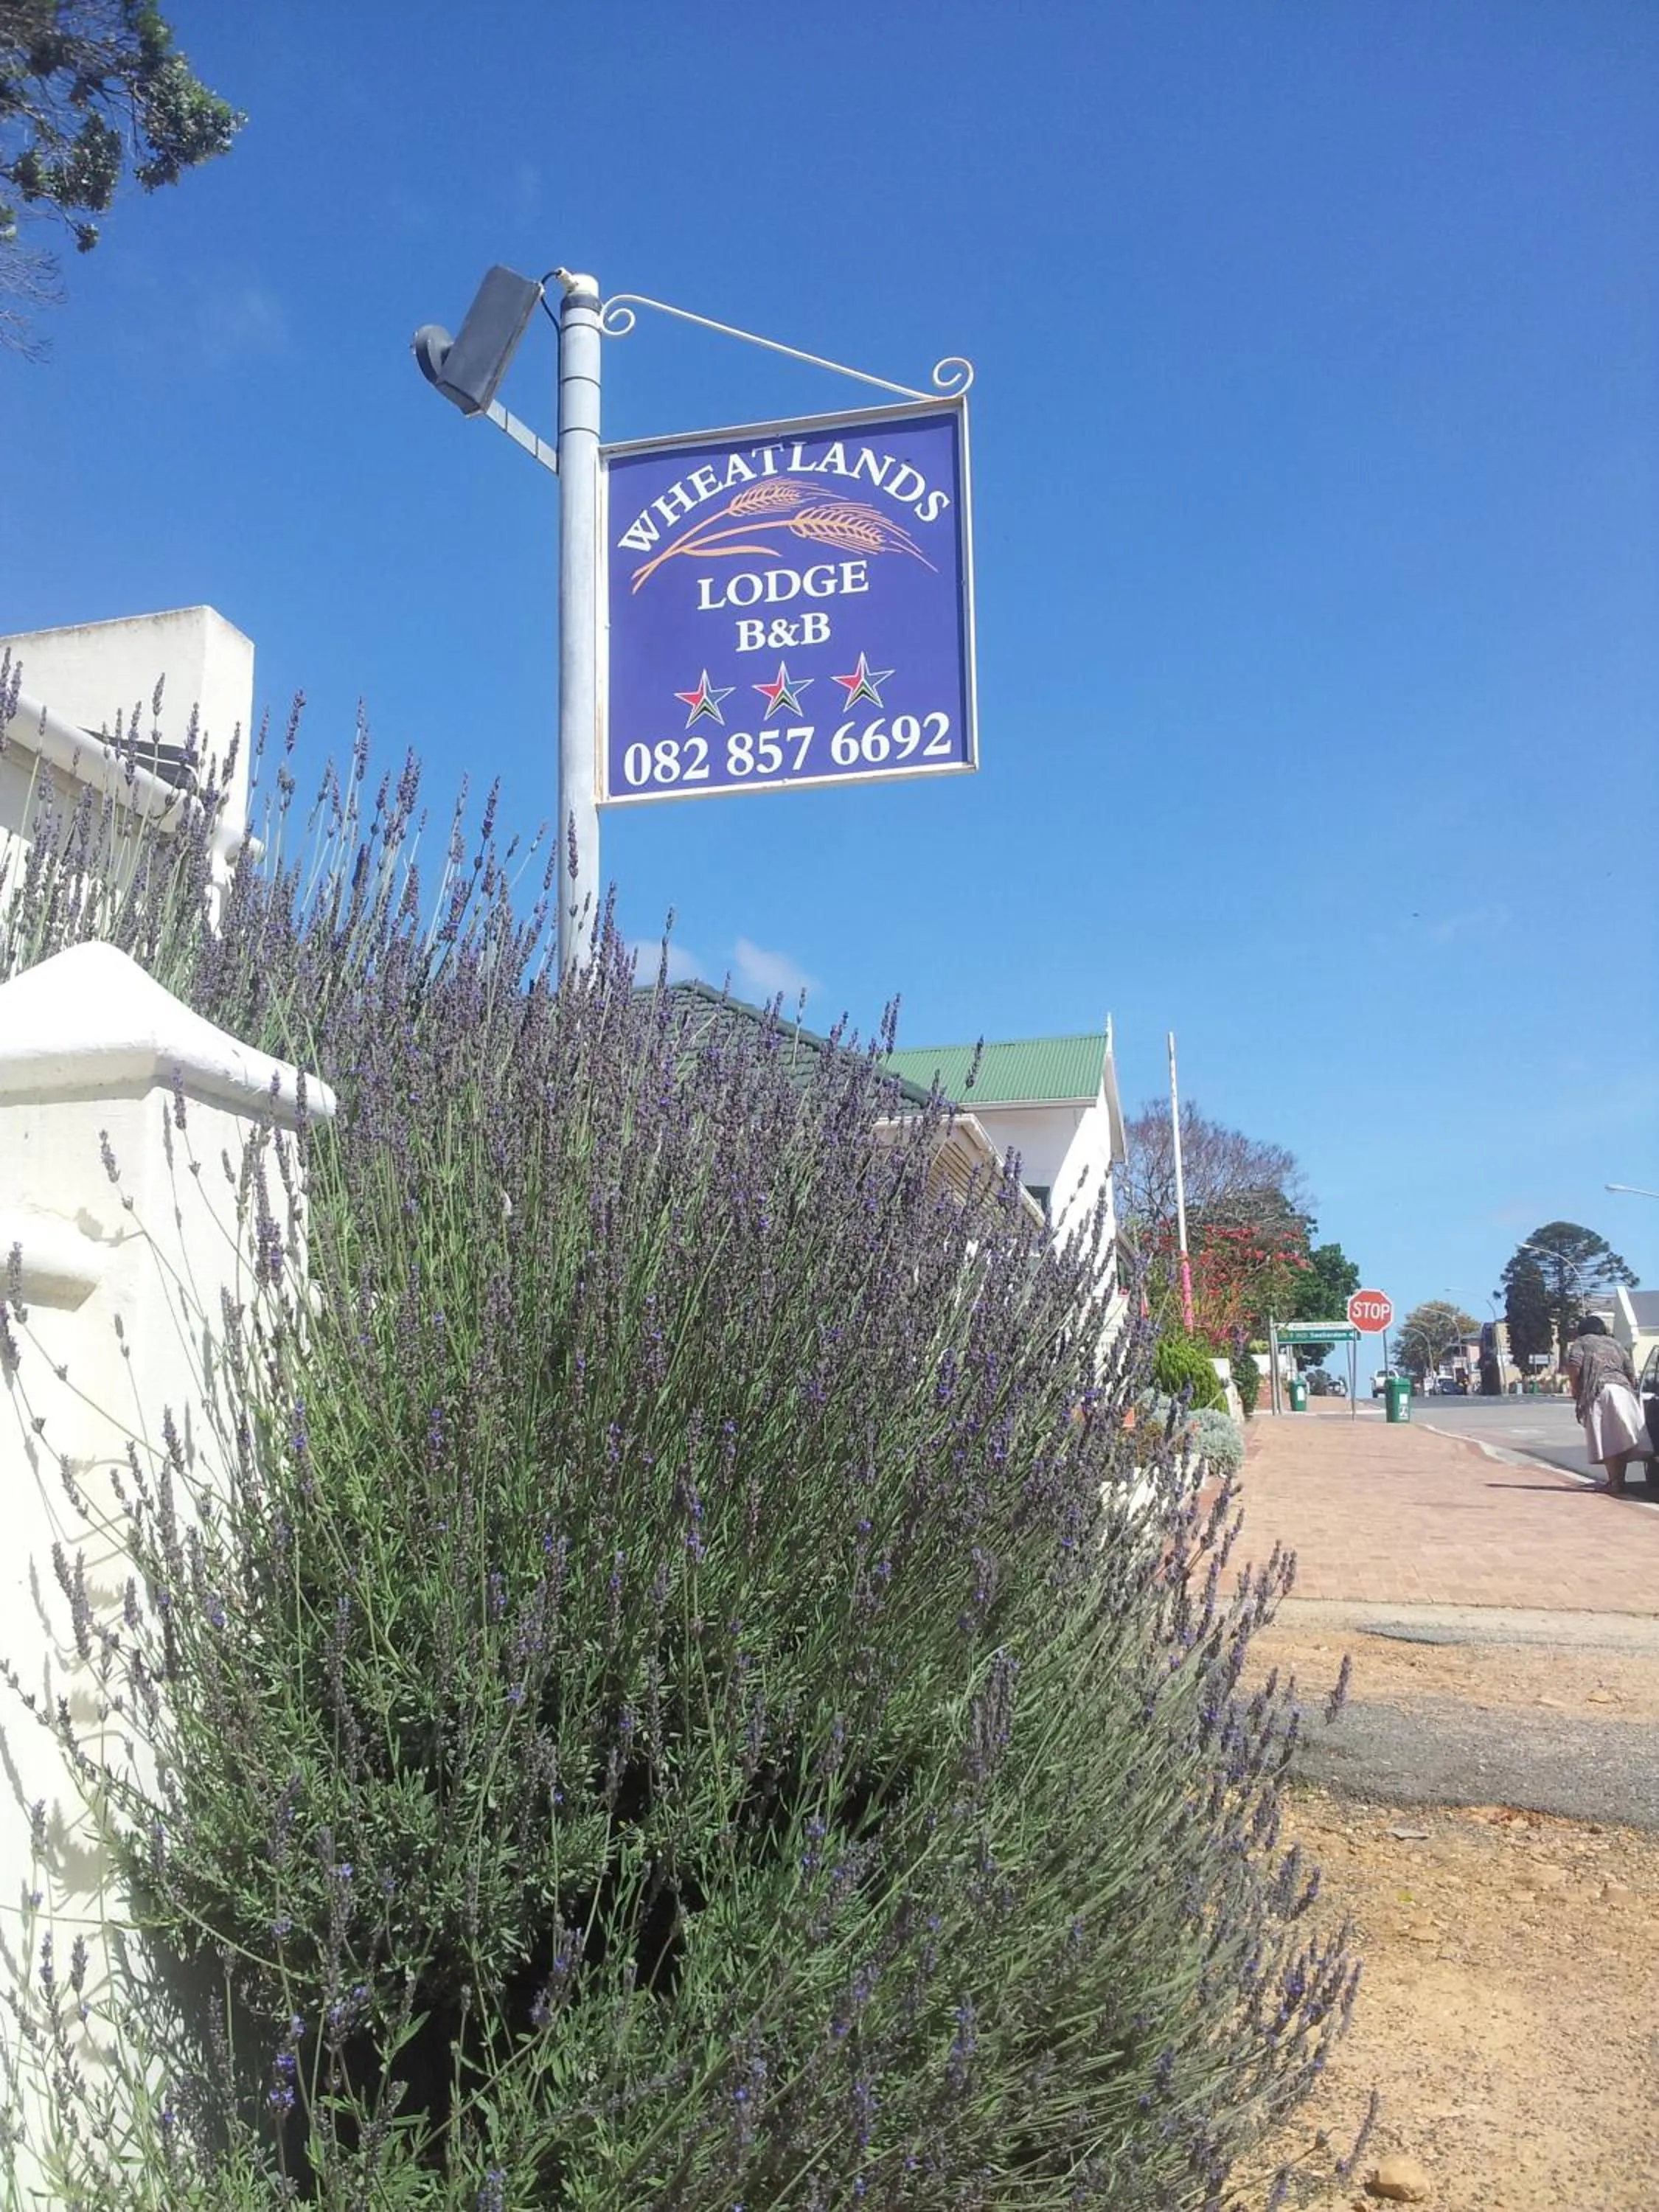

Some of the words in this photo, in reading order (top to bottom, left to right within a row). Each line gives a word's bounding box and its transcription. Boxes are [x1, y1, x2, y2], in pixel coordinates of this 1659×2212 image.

[617, 441, 950, 554] WHEATLANDS
[697, 560, 869, 611] LODGE
[735, 612, 831, 652] B&B
[623, 737, 710, 786] 082
[726, 726, 815, 776] 857
[830, 712, 952, 765] 6692
[1352, 1301, 1390, 1321] STOP
